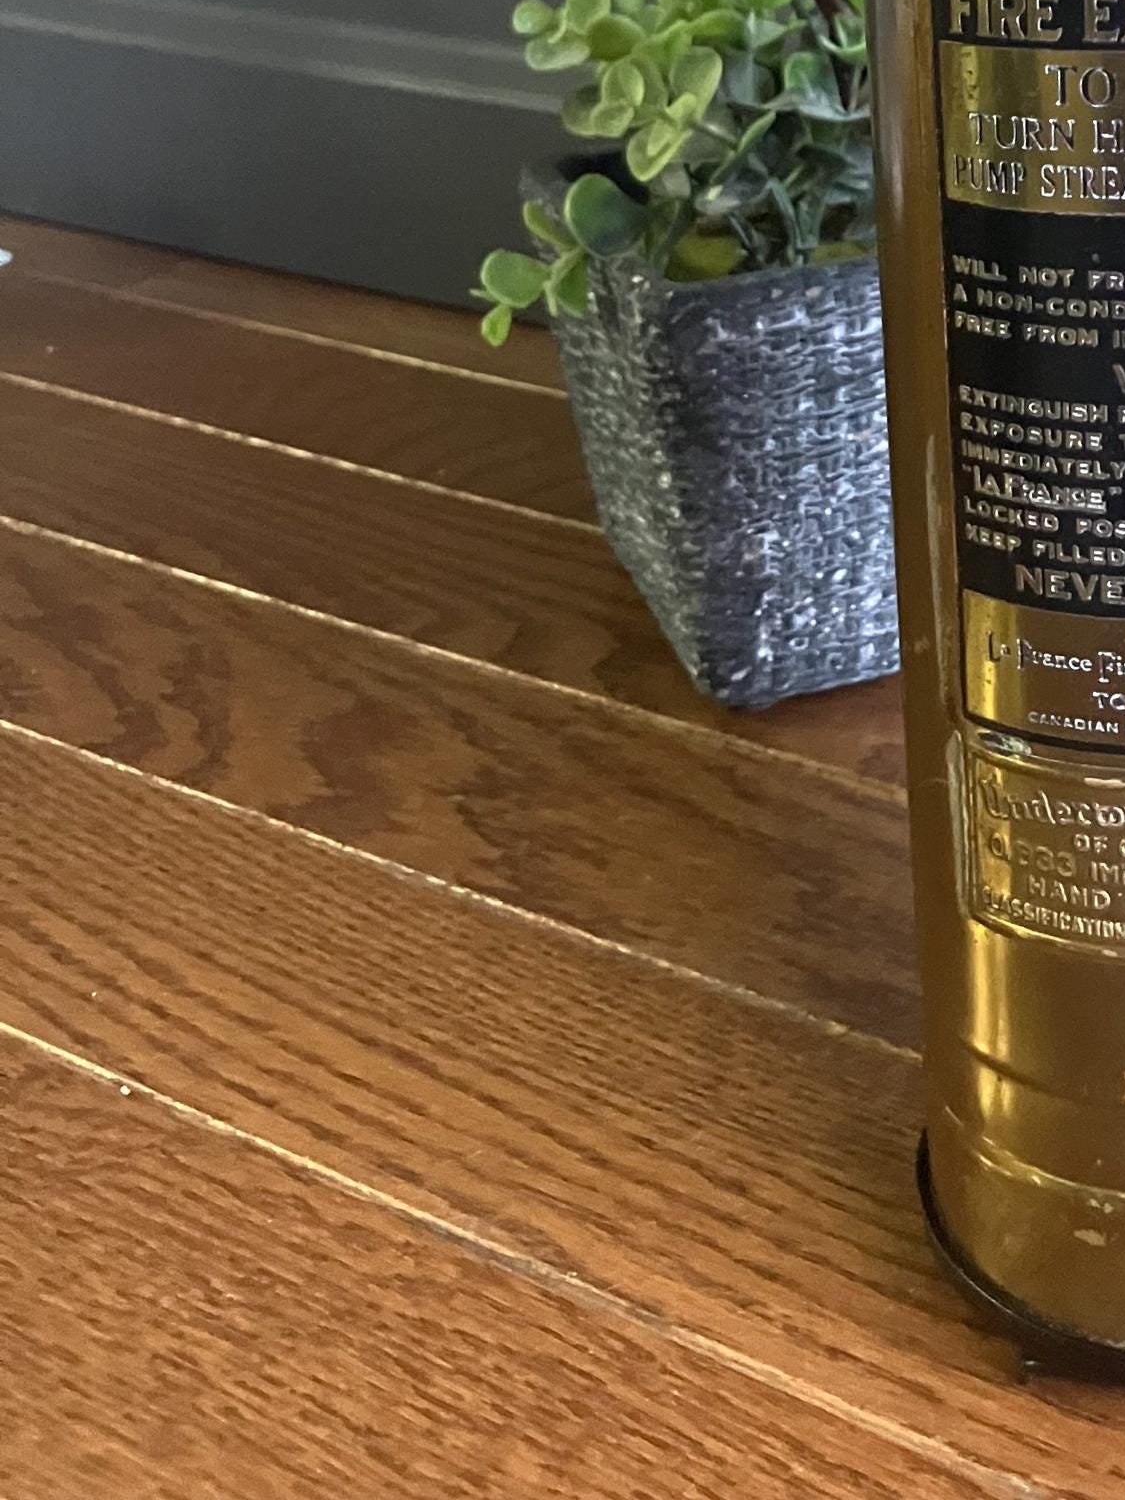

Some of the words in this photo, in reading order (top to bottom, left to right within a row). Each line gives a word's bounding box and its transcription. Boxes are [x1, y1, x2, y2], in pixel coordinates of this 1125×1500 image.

[1045, 64, 1117, 109] TO
[969, 112, 1075, 151] TURN
[953, 154, 1025, 195] PUMP
[952, 254, 1007, 282] WILL
[1019, 266, 1075, 288] NOT
[953, 283, 968, 303] A
[954, 311, 1012, 339] FREE
[1023, 323, 1099, 347] FROM
[958, 384, 1109, 424] EXTINGUISH
[960, 411, 1103, 452] EXPOSURE
[964, 494, 1060, 533] LOCKED
[964, 522, 1022, 552] KEEP
[1016, 637, 1093, 671] France
[1028, 711, 1119, 735] CANADIAN
[1073, 832, 1108, 853] OF
[1028, 873, 1112, 910] HAND
